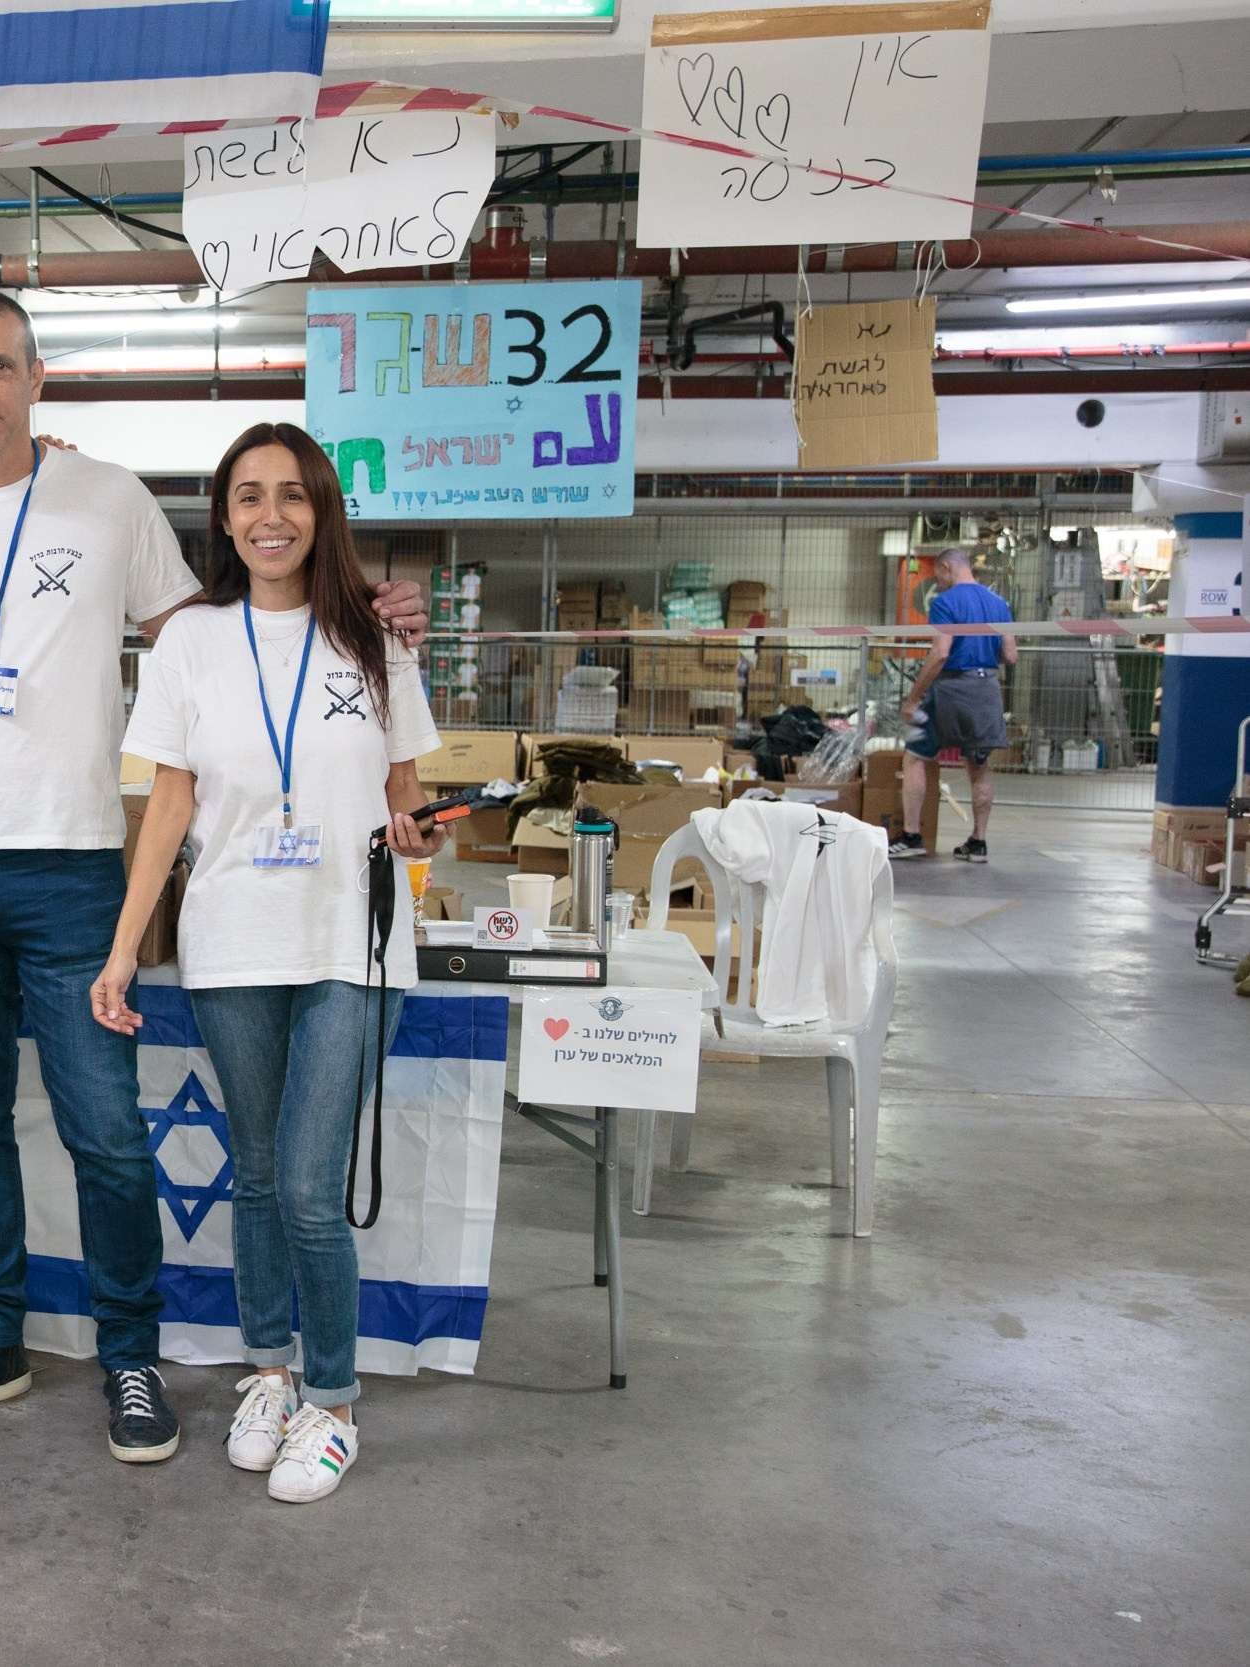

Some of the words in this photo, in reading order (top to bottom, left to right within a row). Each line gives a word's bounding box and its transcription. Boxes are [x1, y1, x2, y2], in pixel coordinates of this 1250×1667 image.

[843, 35, 938, 126] אין
[350, 115, 461, 174] נא
[184, 118, 306, 189] לגשת
[721, 157, 896, 202] כניסה
[252, 191, 469, 273] לאחראי
[856, 323, 892, 340] נא
[817, 352, 886, 376] לגשת
[533, 392, 621, 468] עם
[402, 433, 515, 472] ישראל
[1200, 591, 1228, 603] ROW
[326, 671, 344, 680] ברזל
[493, 915, 513, 926] לשון
[594, 1027, 625, 1041] שלנו
[627, 1030, 678, 1045] לחיילים
[554, 1048, 576, 1063] ערן
[579, 1049, 599, 1062] של
[601, 1051, 663, 1067] המלאכים
